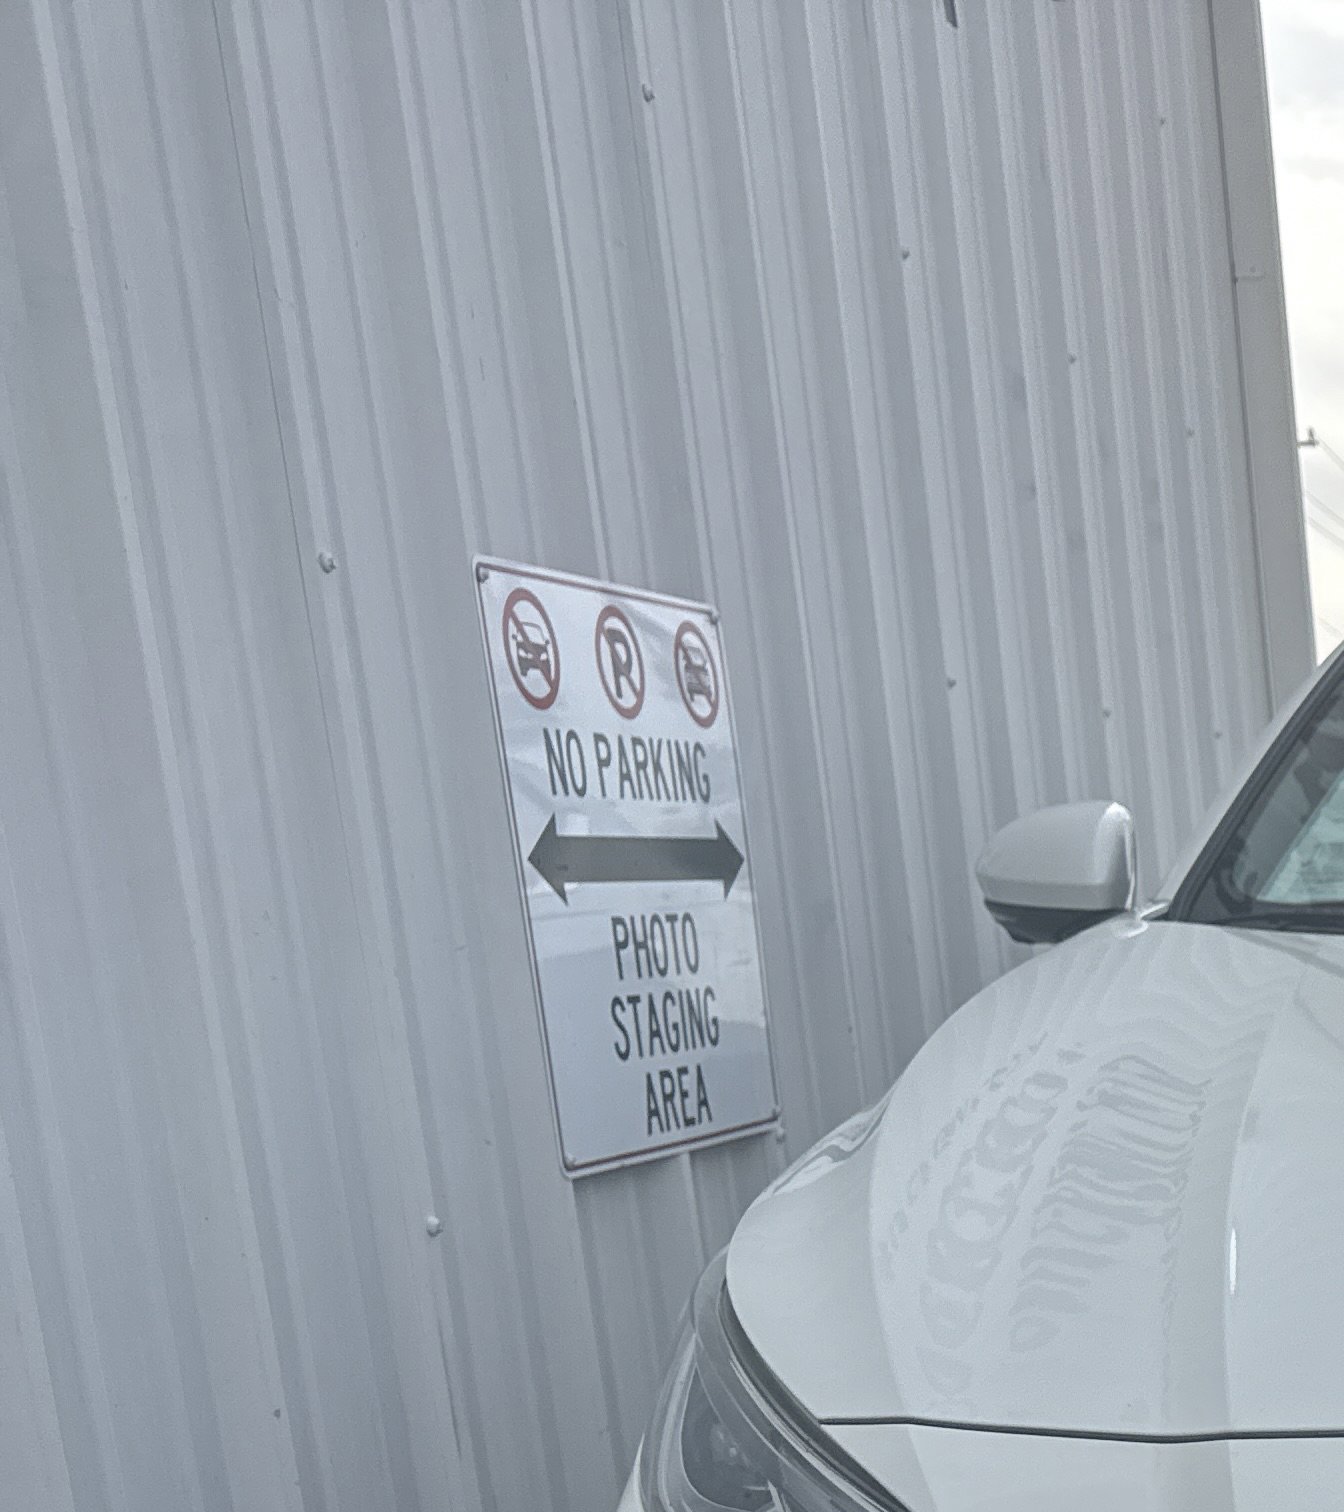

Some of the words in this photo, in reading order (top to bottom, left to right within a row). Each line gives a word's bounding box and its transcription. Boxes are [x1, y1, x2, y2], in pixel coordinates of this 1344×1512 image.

[543, 727, 587, 798] NO
[593, 733, 711, 803] PARKING
[611, 912, 700, 980] PHOTO
[611, 986, 720, 1061] STAGING
[646, 1063, 713, 1136] AREA
